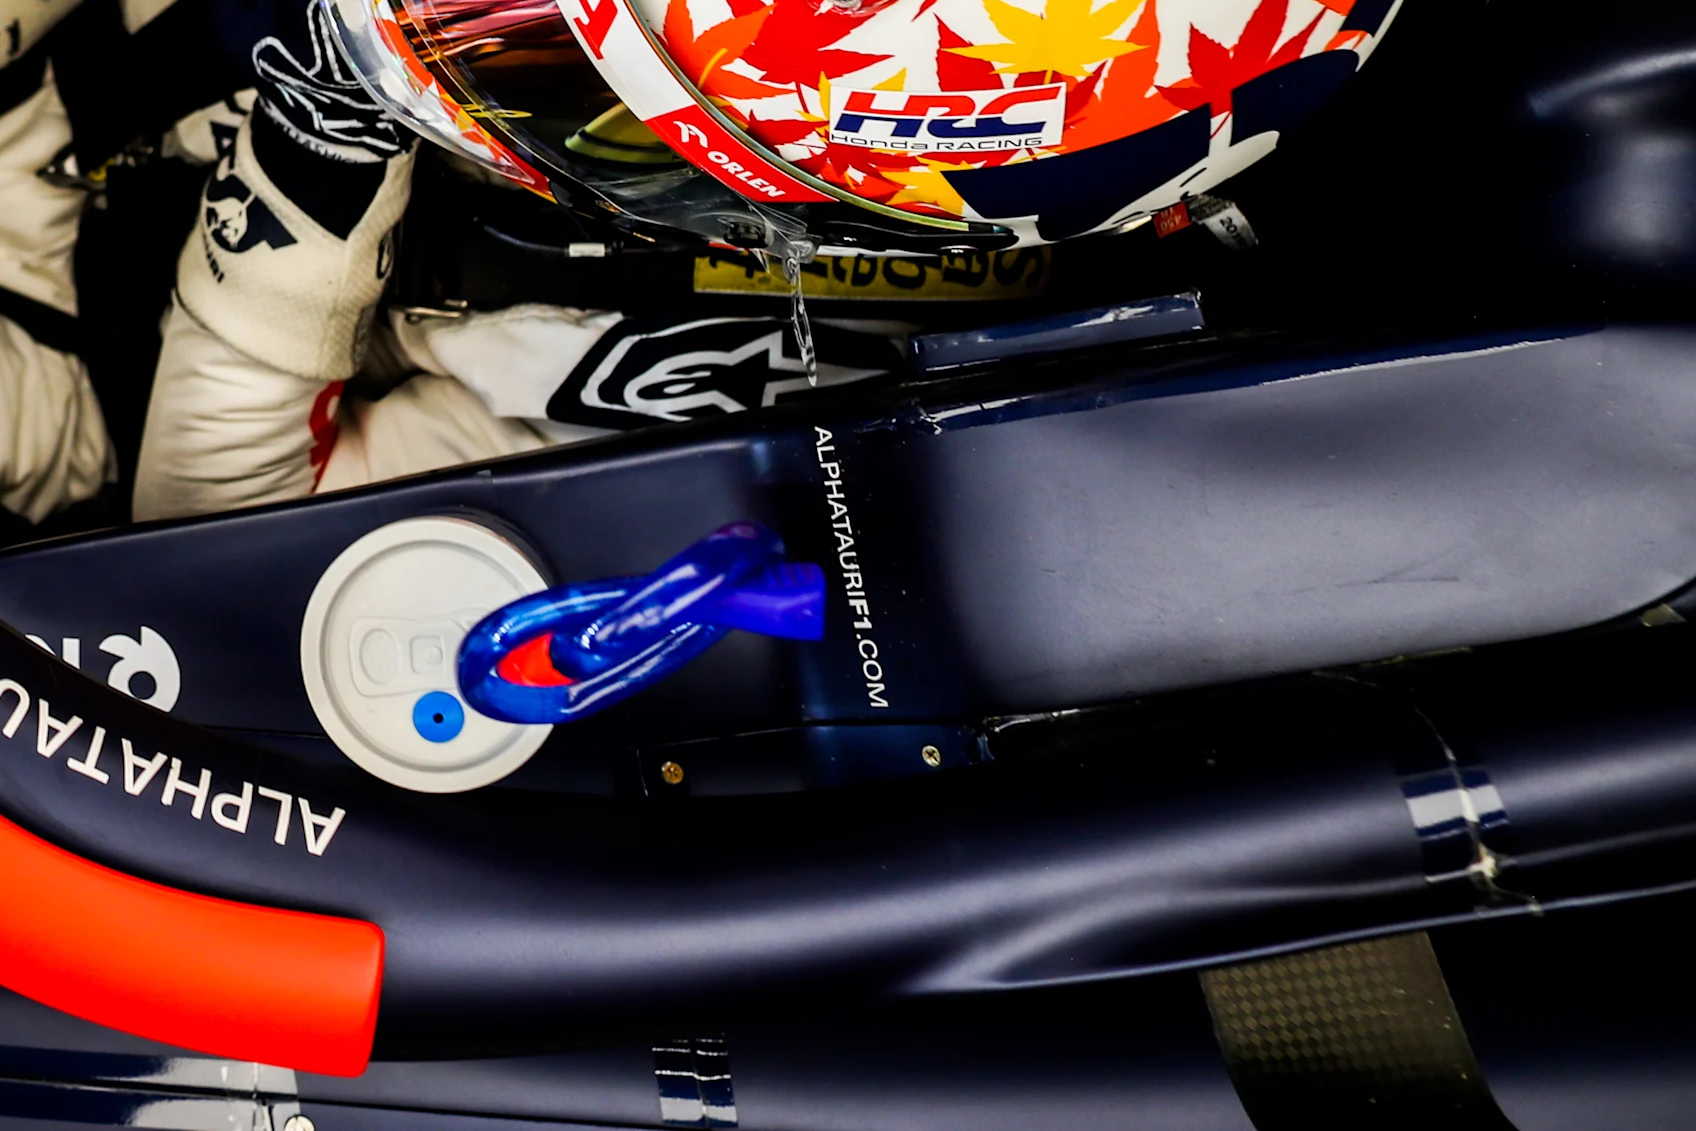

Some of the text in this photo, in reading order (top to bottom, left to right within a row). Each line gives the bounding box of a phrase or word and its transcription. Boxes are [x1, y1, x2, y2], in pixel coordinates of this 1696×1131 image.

[834, 86, 1060, 138] HRC
[830, 133, 1043, 152] Honda RACING
[706, 148, 785, 199] ORLEN
[814, 425, 889, 708] ALPHATAURIF1.COM
